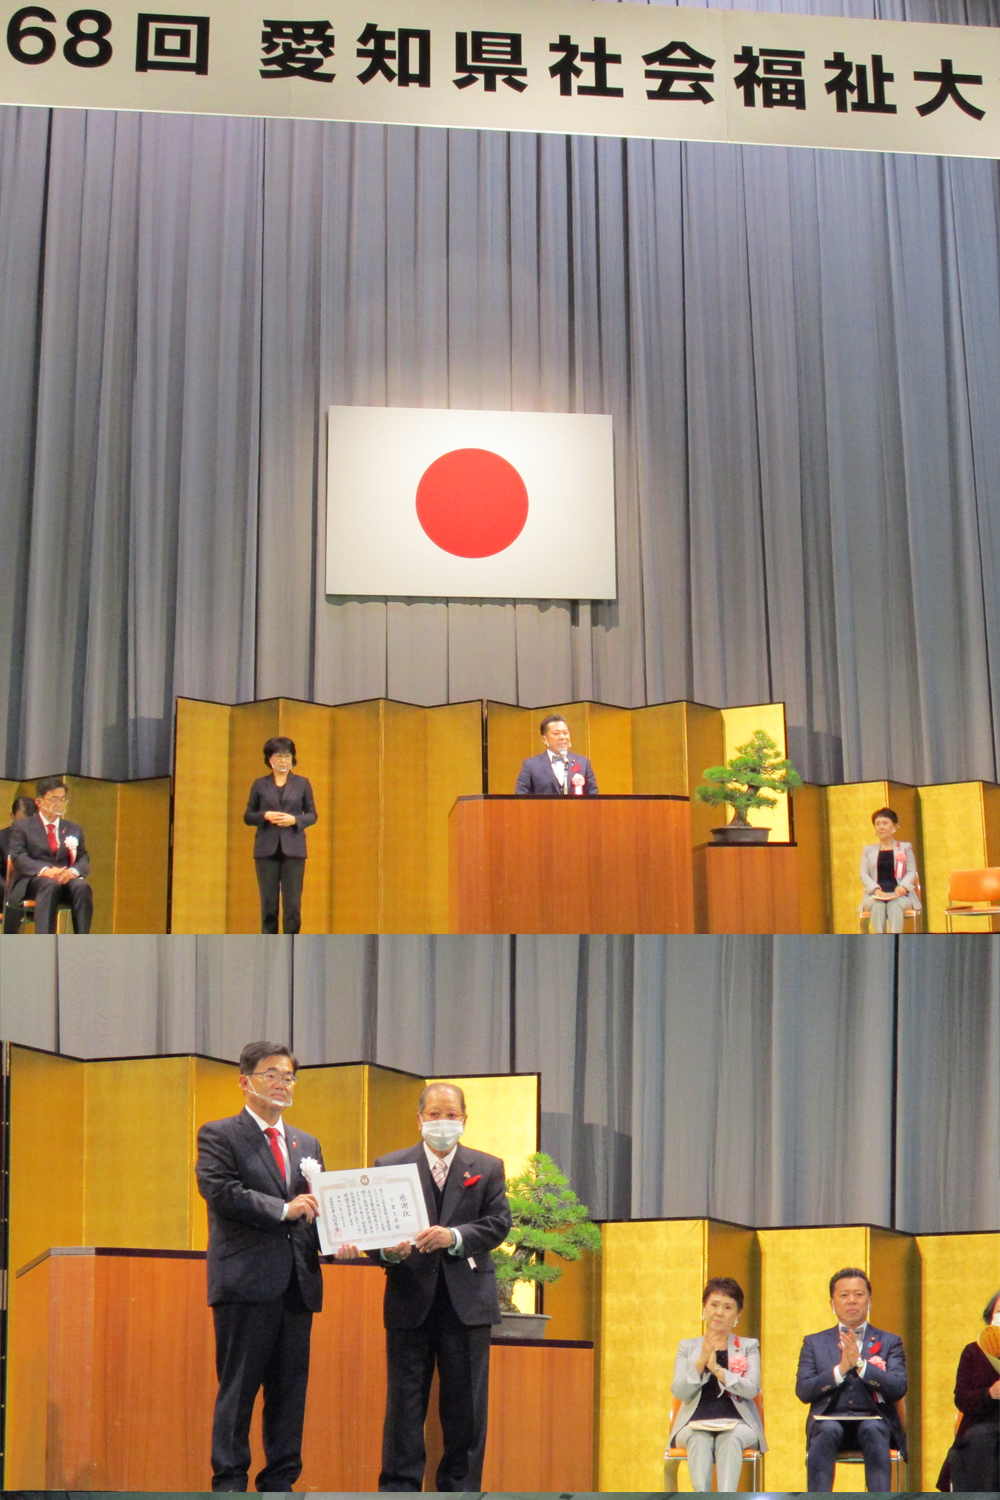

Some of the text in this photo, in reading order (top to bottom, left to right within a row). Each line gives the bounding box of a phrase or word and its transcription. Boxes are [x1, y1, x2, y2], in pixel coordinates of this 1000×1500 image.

[6, 5, 986, 122] 68回 愛知県社会福祉大
